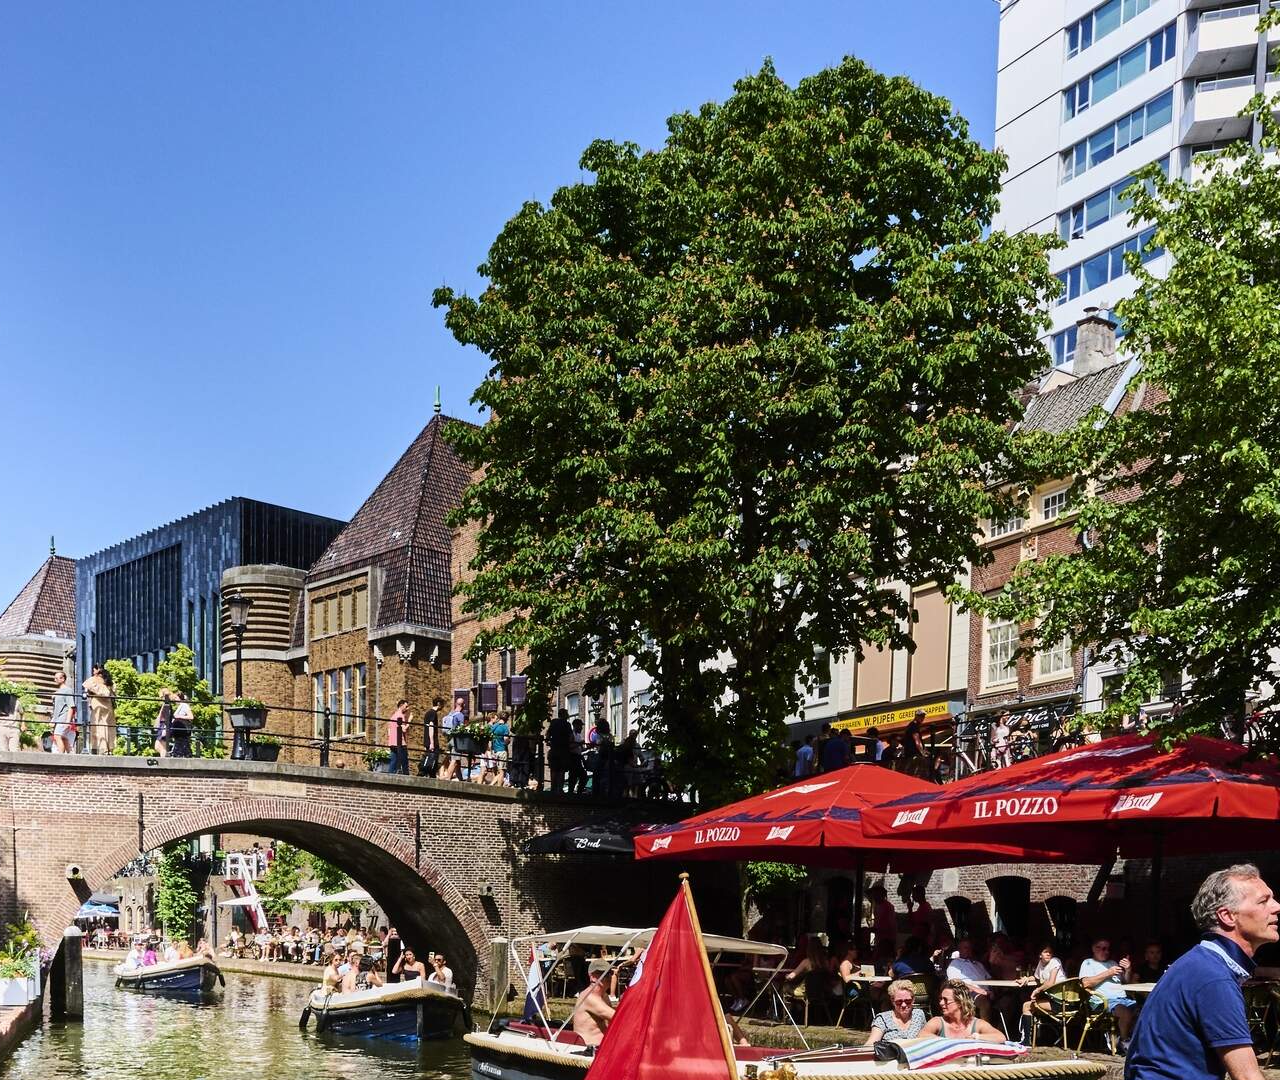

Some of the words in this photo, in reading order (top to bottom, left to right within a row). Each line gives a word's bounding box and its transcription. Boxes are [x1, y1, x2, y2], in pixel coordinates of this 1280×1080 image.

[872, 713, 895, 725] PIJPER
[973, 801, 992, 819] IL
[994, 797, 1058, 817] POZZO
[694, 830, 705, 844] IL
[706, 827, 741, 843] POZZO
[574, 838, 601, 849] Bud
